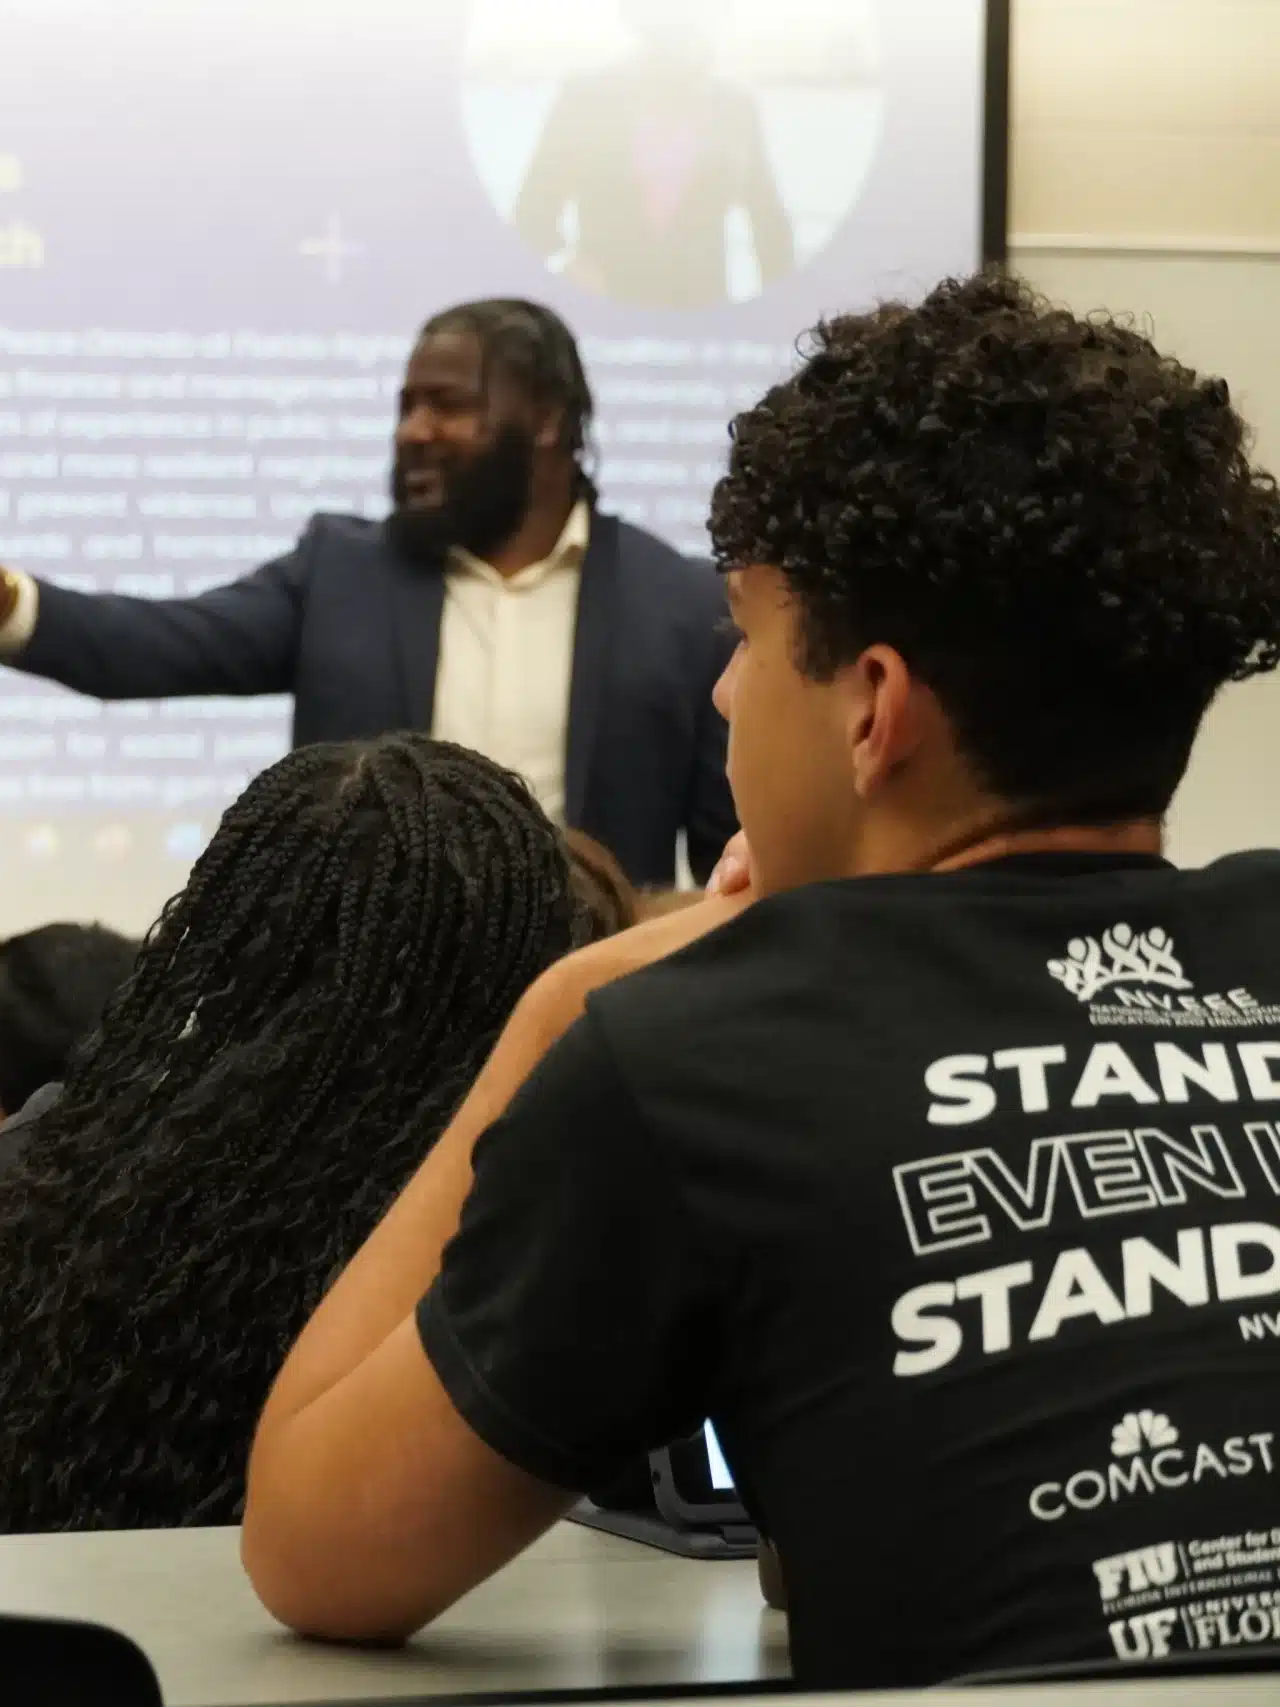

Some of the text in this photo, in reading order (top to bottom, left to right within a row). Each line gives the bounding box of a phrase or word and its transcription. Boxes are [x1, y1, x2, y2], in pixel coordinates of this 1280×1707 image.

[892, 1124, 1246, 1256] EVEN
[891, 1221, 1280, 1377] STAND
[1029, 1432, 1274, 1521] COMCAST
[1092, 1540, 1179, 1601] FIU
[1108, 1606, 1179, 1661] UF
